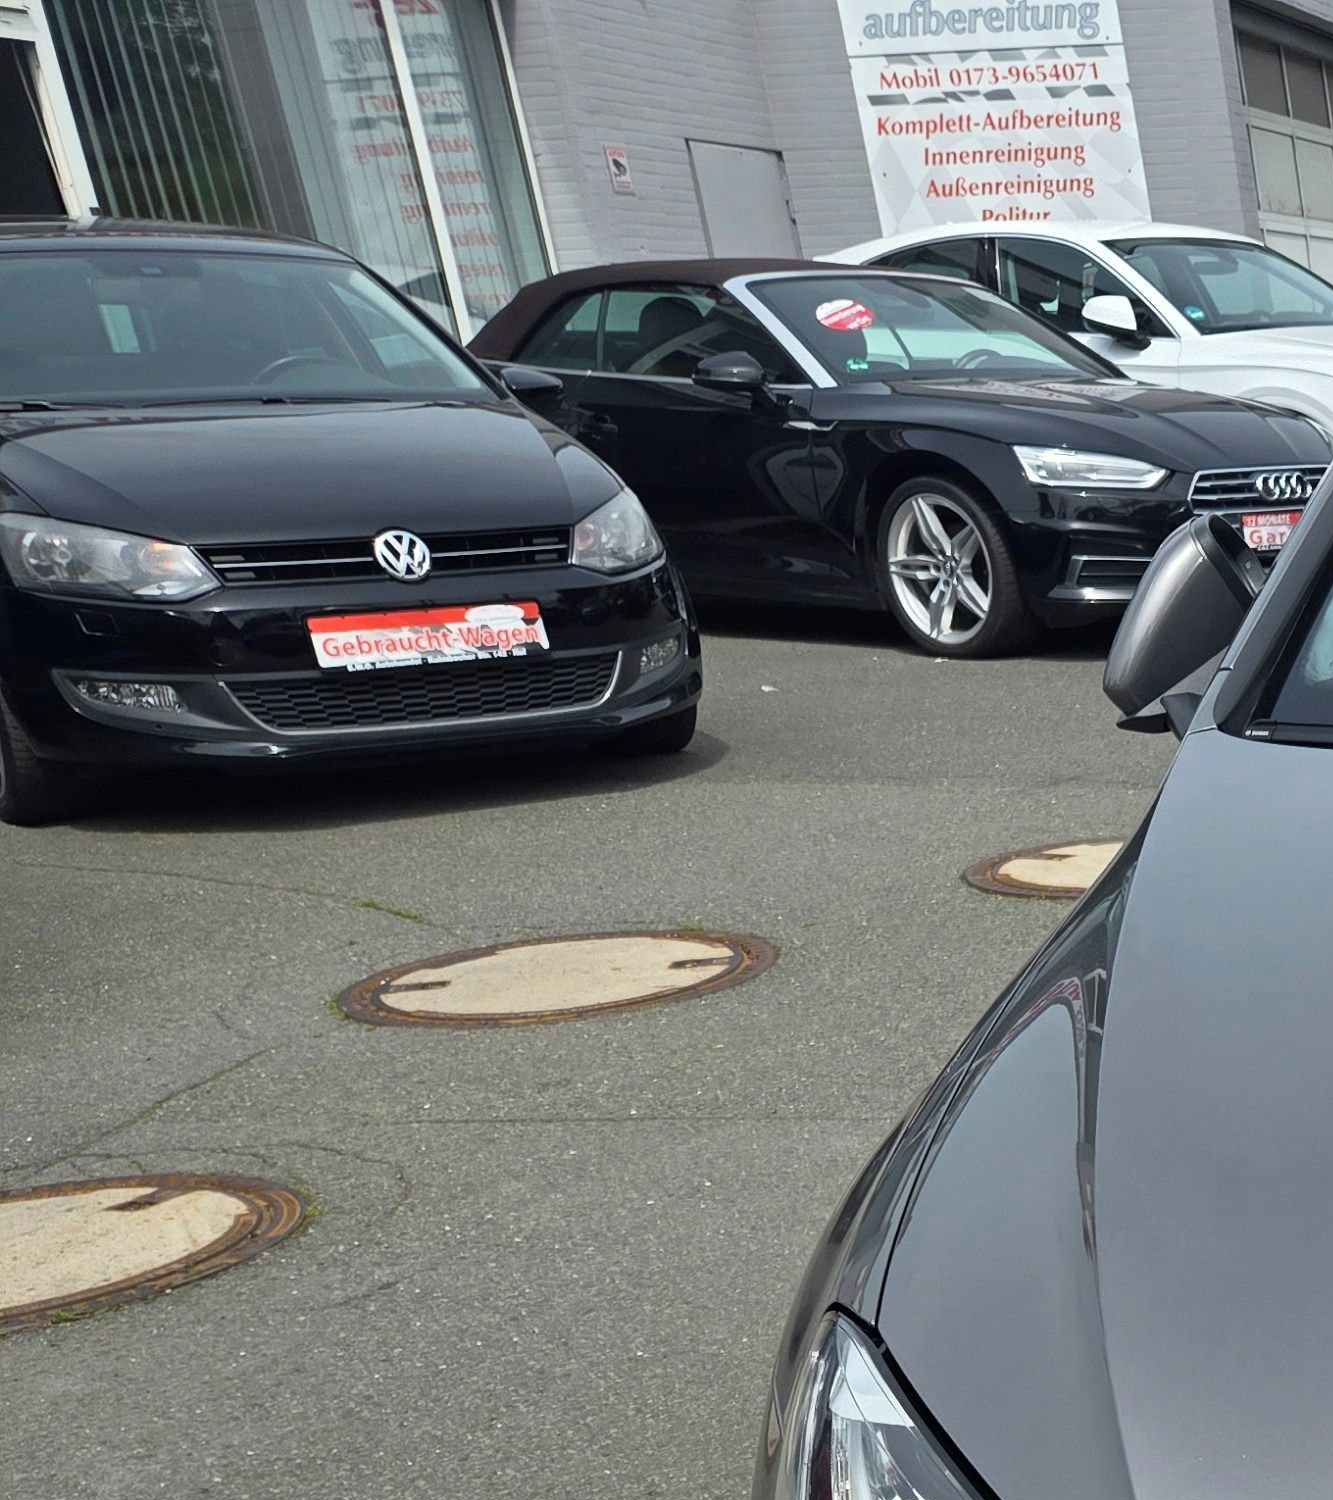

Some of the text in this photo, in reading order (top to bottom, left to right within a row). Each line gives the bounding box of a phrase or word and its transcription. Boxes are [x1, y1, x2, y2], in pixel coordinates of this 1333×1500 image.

[863, 1, 1100, 39] aufbereitung
[880, 62, 1100, 90] Mobil 0173-9654071
[877, 107, 1122, 139] Komplett-Aufbereitung
[924, 142, 1085, 168] Innenreinigung
[926, 174, 1095, 199] Außenreinigung
